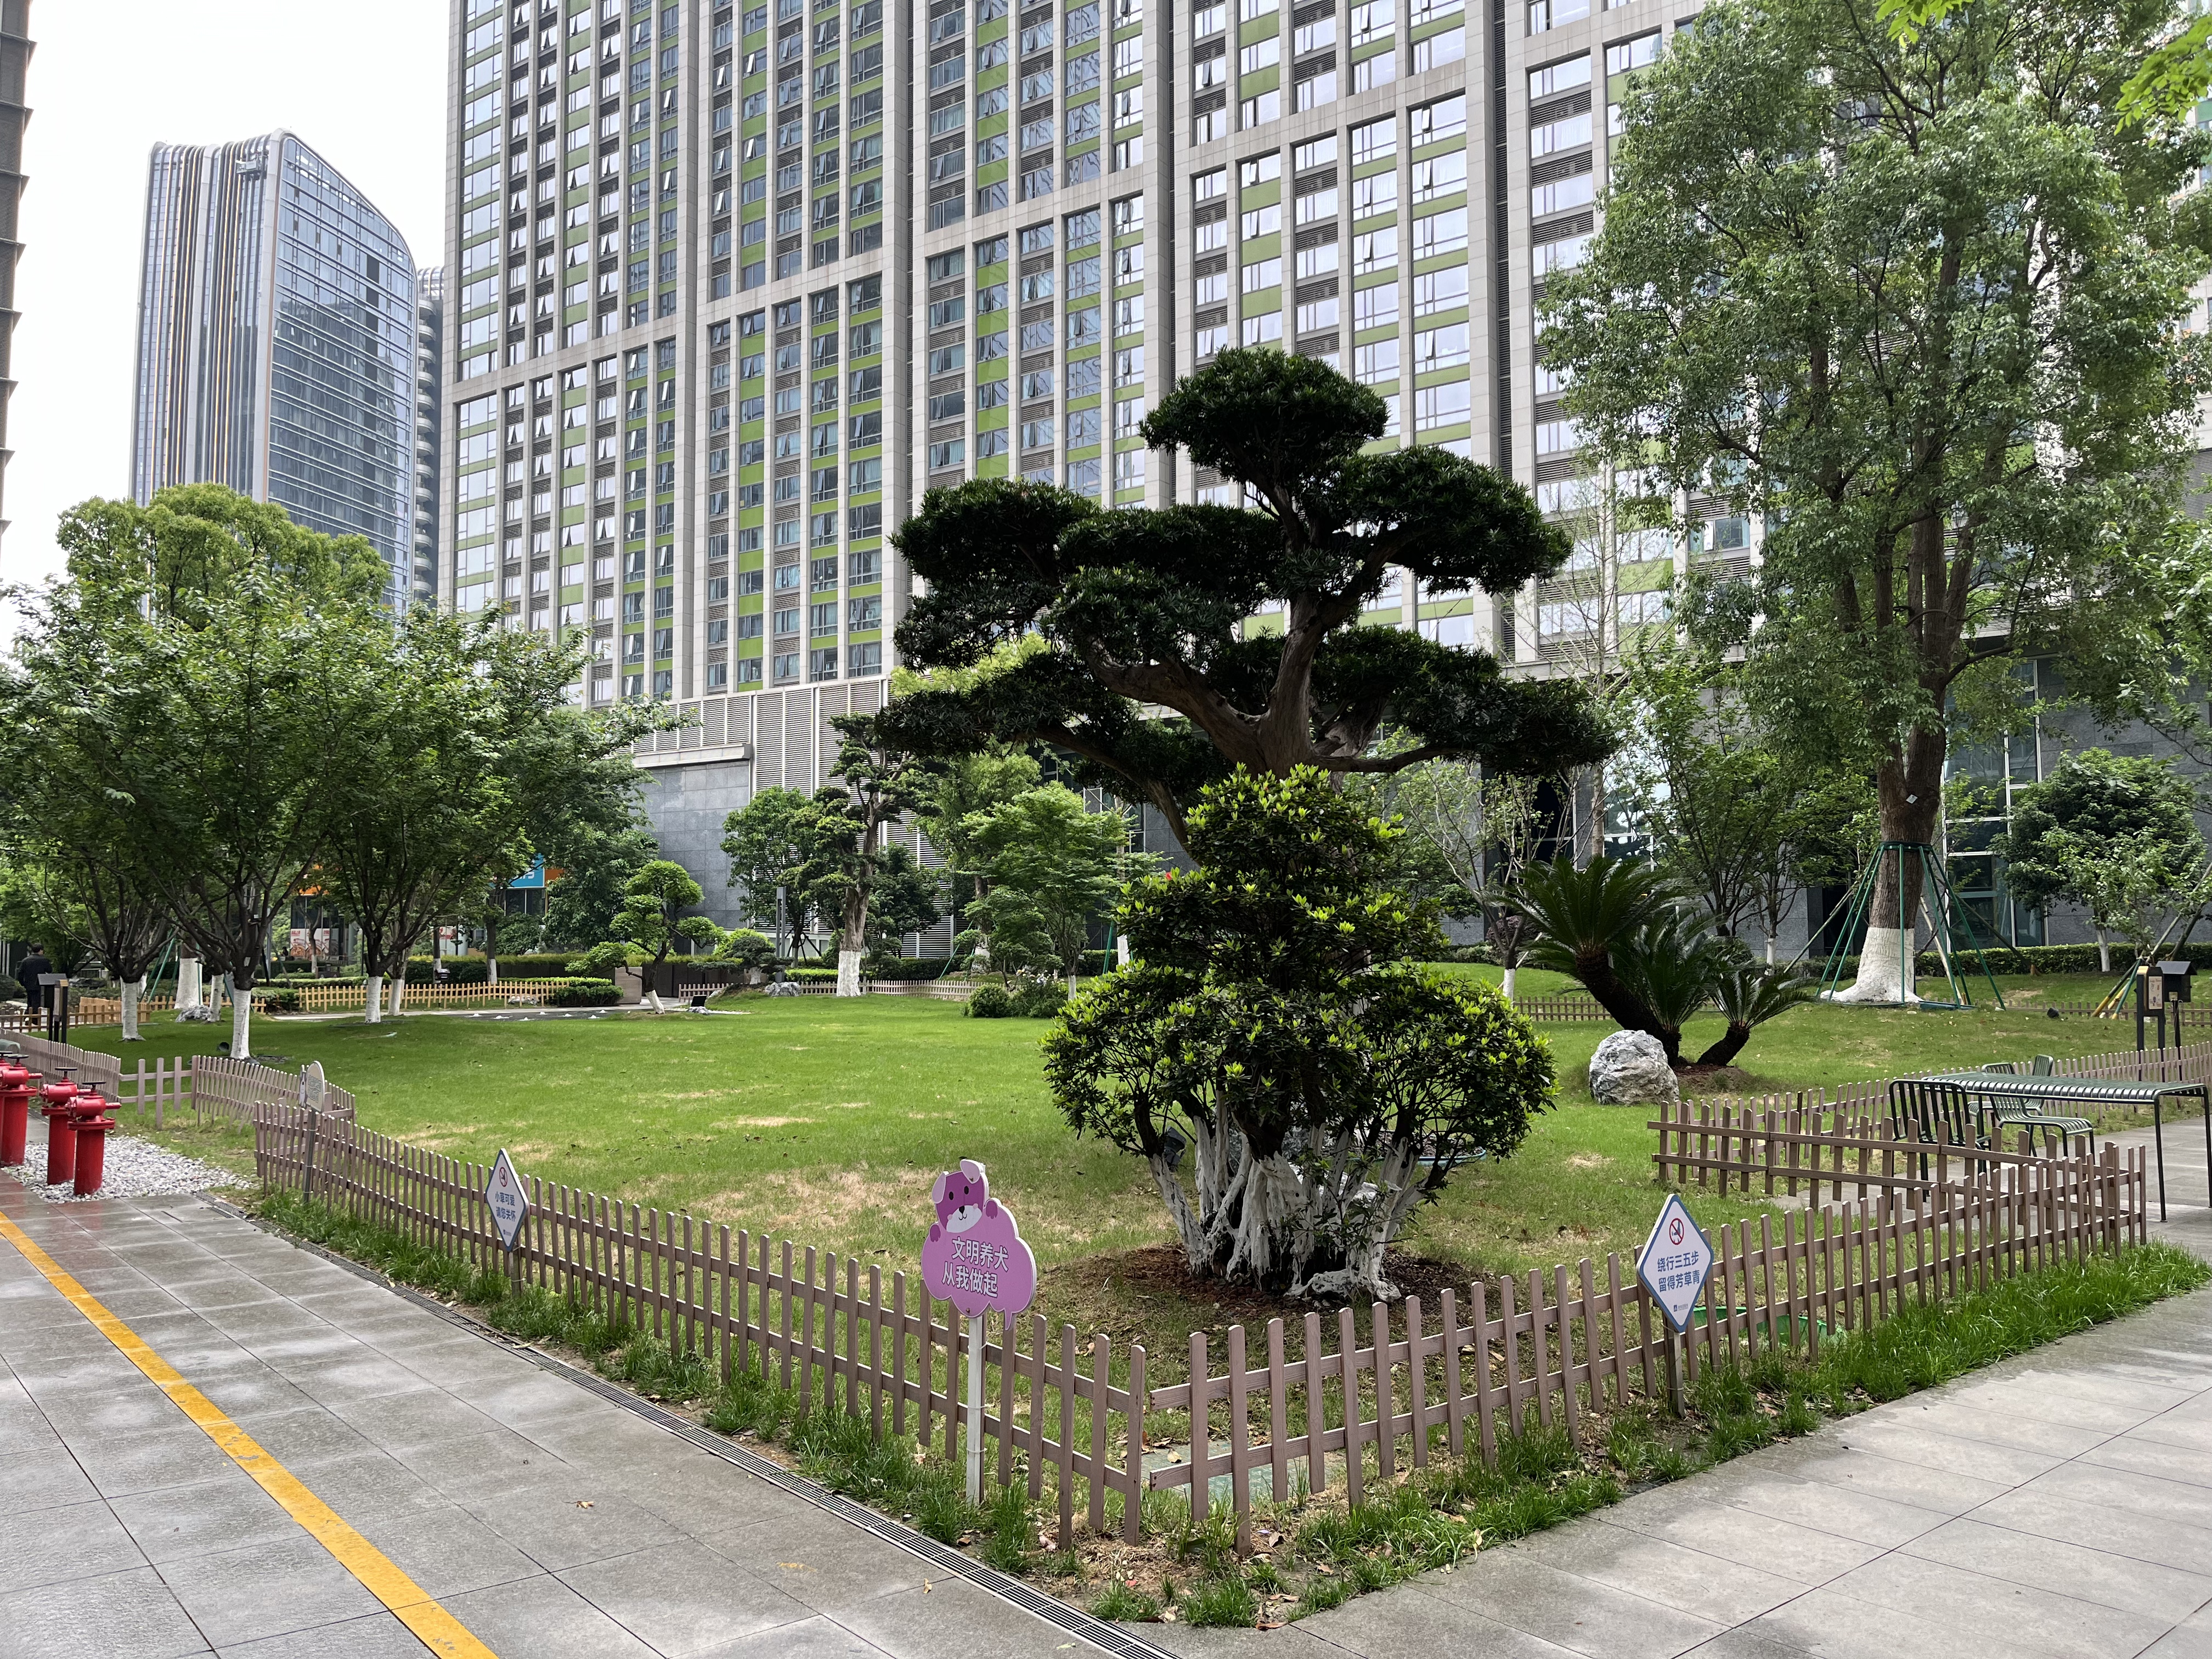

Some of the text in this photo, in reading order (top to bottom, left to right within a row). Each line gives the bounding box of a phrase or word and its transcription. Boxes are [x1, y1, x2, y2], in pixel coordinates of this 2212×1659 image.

[952, 1237, 1008, 1272] 文明养犬
[1657, 1250, 1699, 1272] 绕行三五步
[942, 1261, 998, 1298] 从我做起
[1658, 1269, 1700, 1293] 留得芳草青
